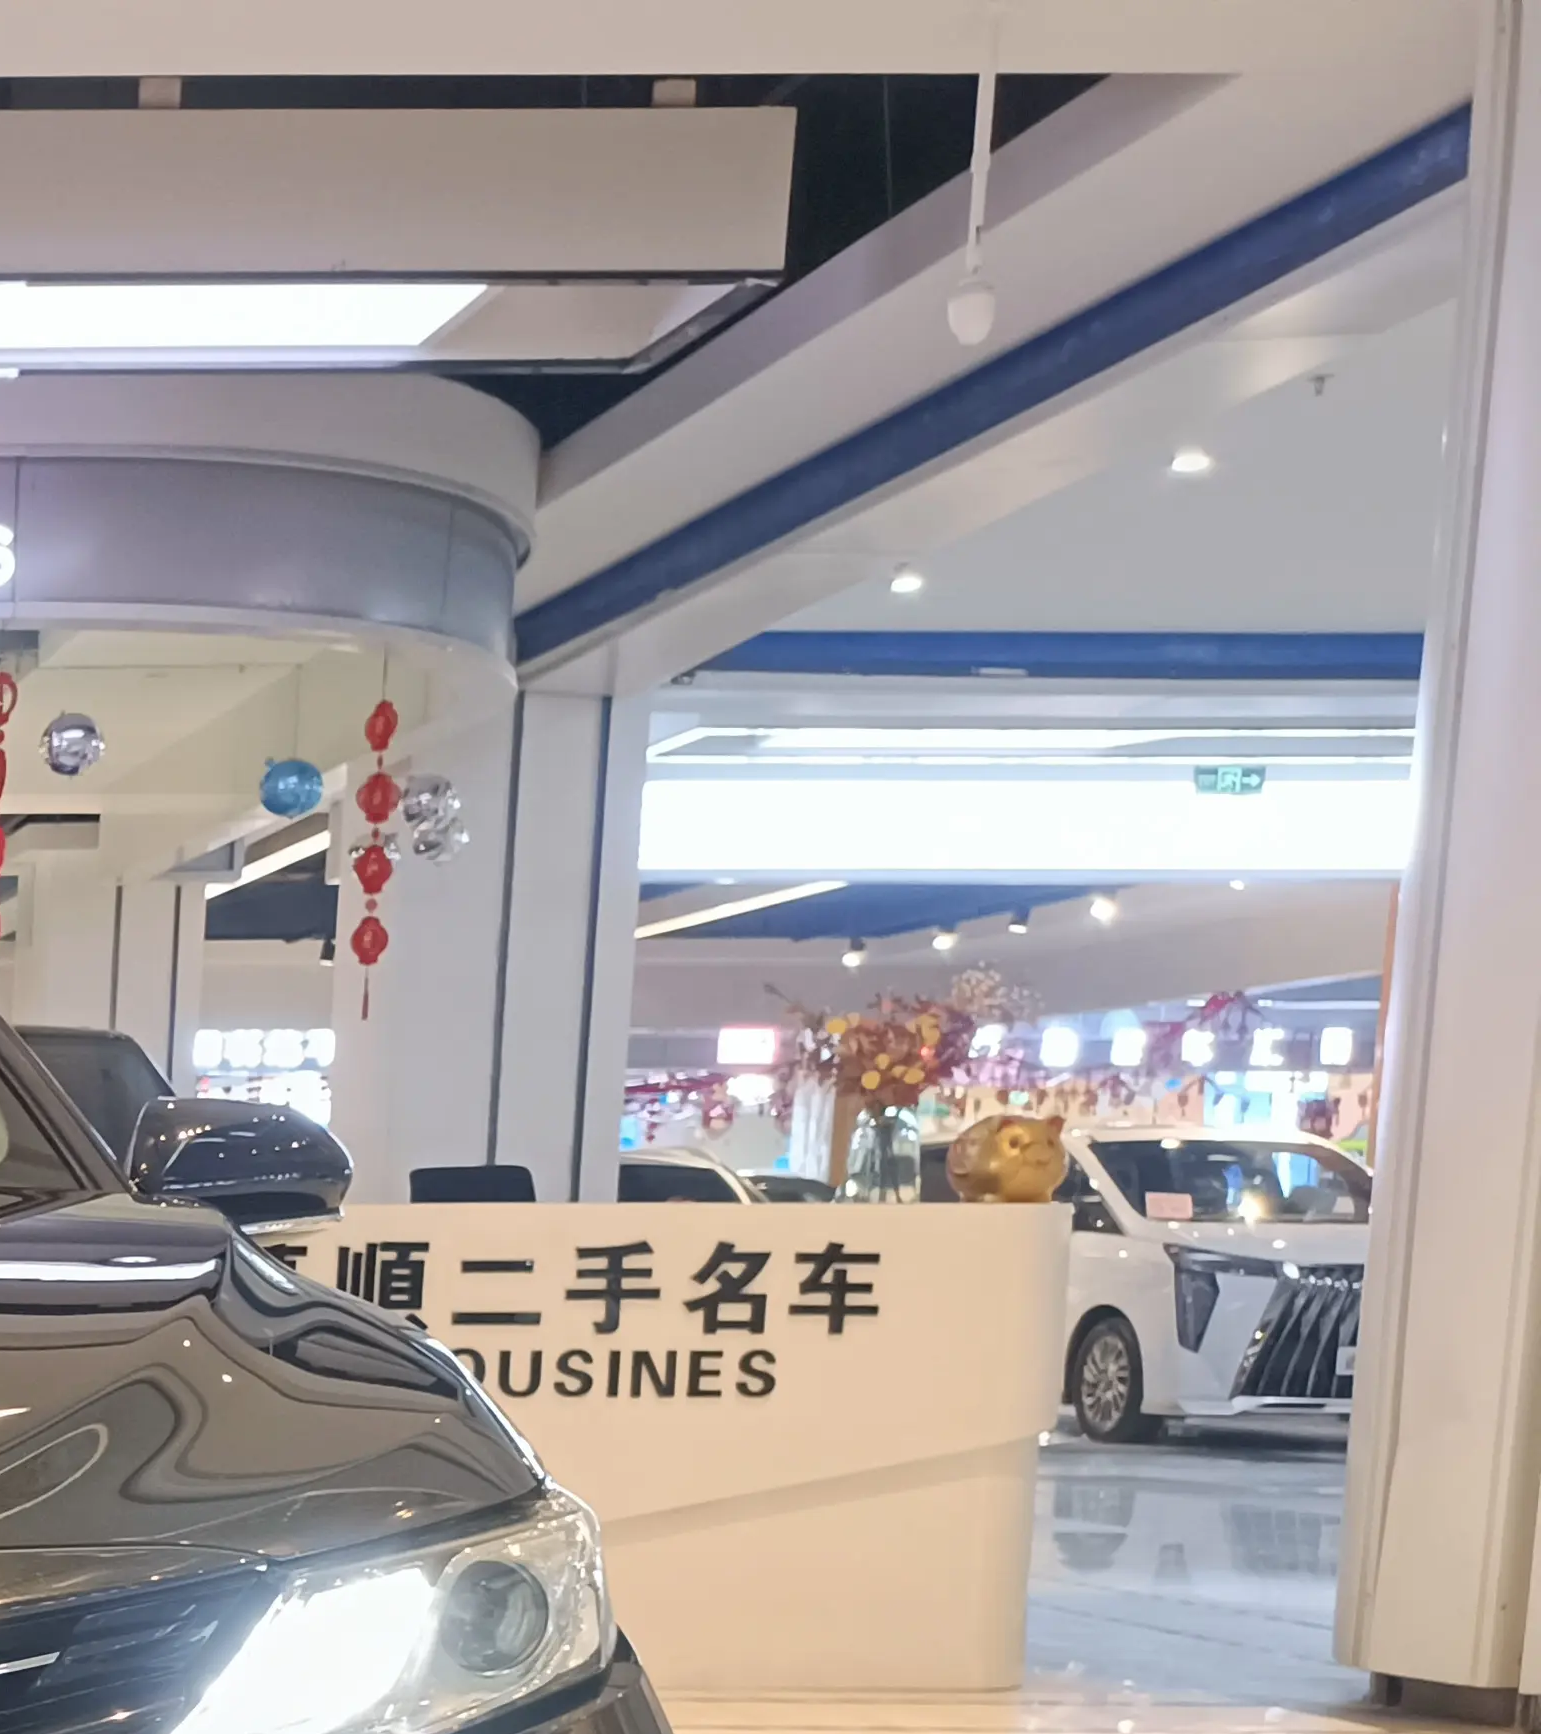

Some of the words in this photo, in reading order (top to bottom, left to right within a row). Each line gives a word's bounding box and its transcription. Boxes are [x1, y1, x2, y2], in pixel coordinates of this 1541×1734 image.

[262, 1240, 882, 1335] 順二手名车
[451, 1347, 779, 1400] OUSINES
